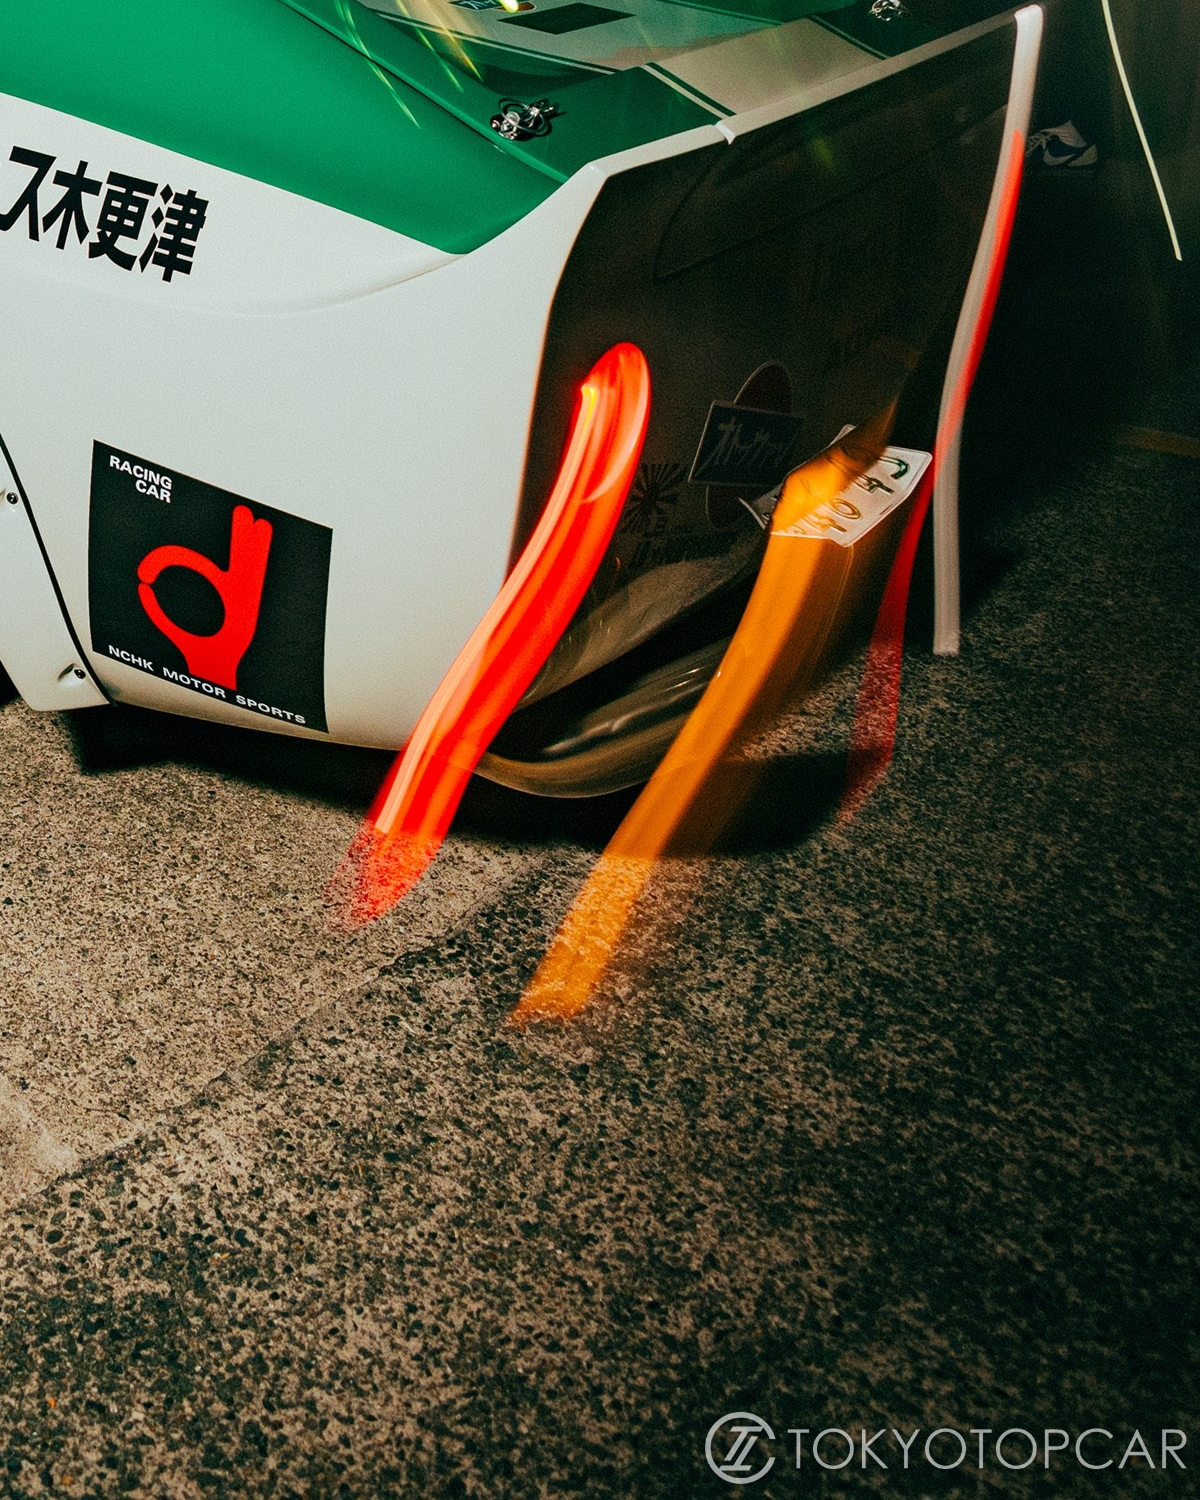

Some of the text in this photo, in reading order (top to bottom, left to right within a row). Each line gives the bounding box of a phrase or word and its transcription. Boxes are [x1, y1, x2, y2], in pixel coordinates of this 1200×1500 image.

[109, 454, 173, 491] RACING
[135, 479, 171, 503] CAR
[108, 644, 306, 725] NCHK MOTOR SPORTS
